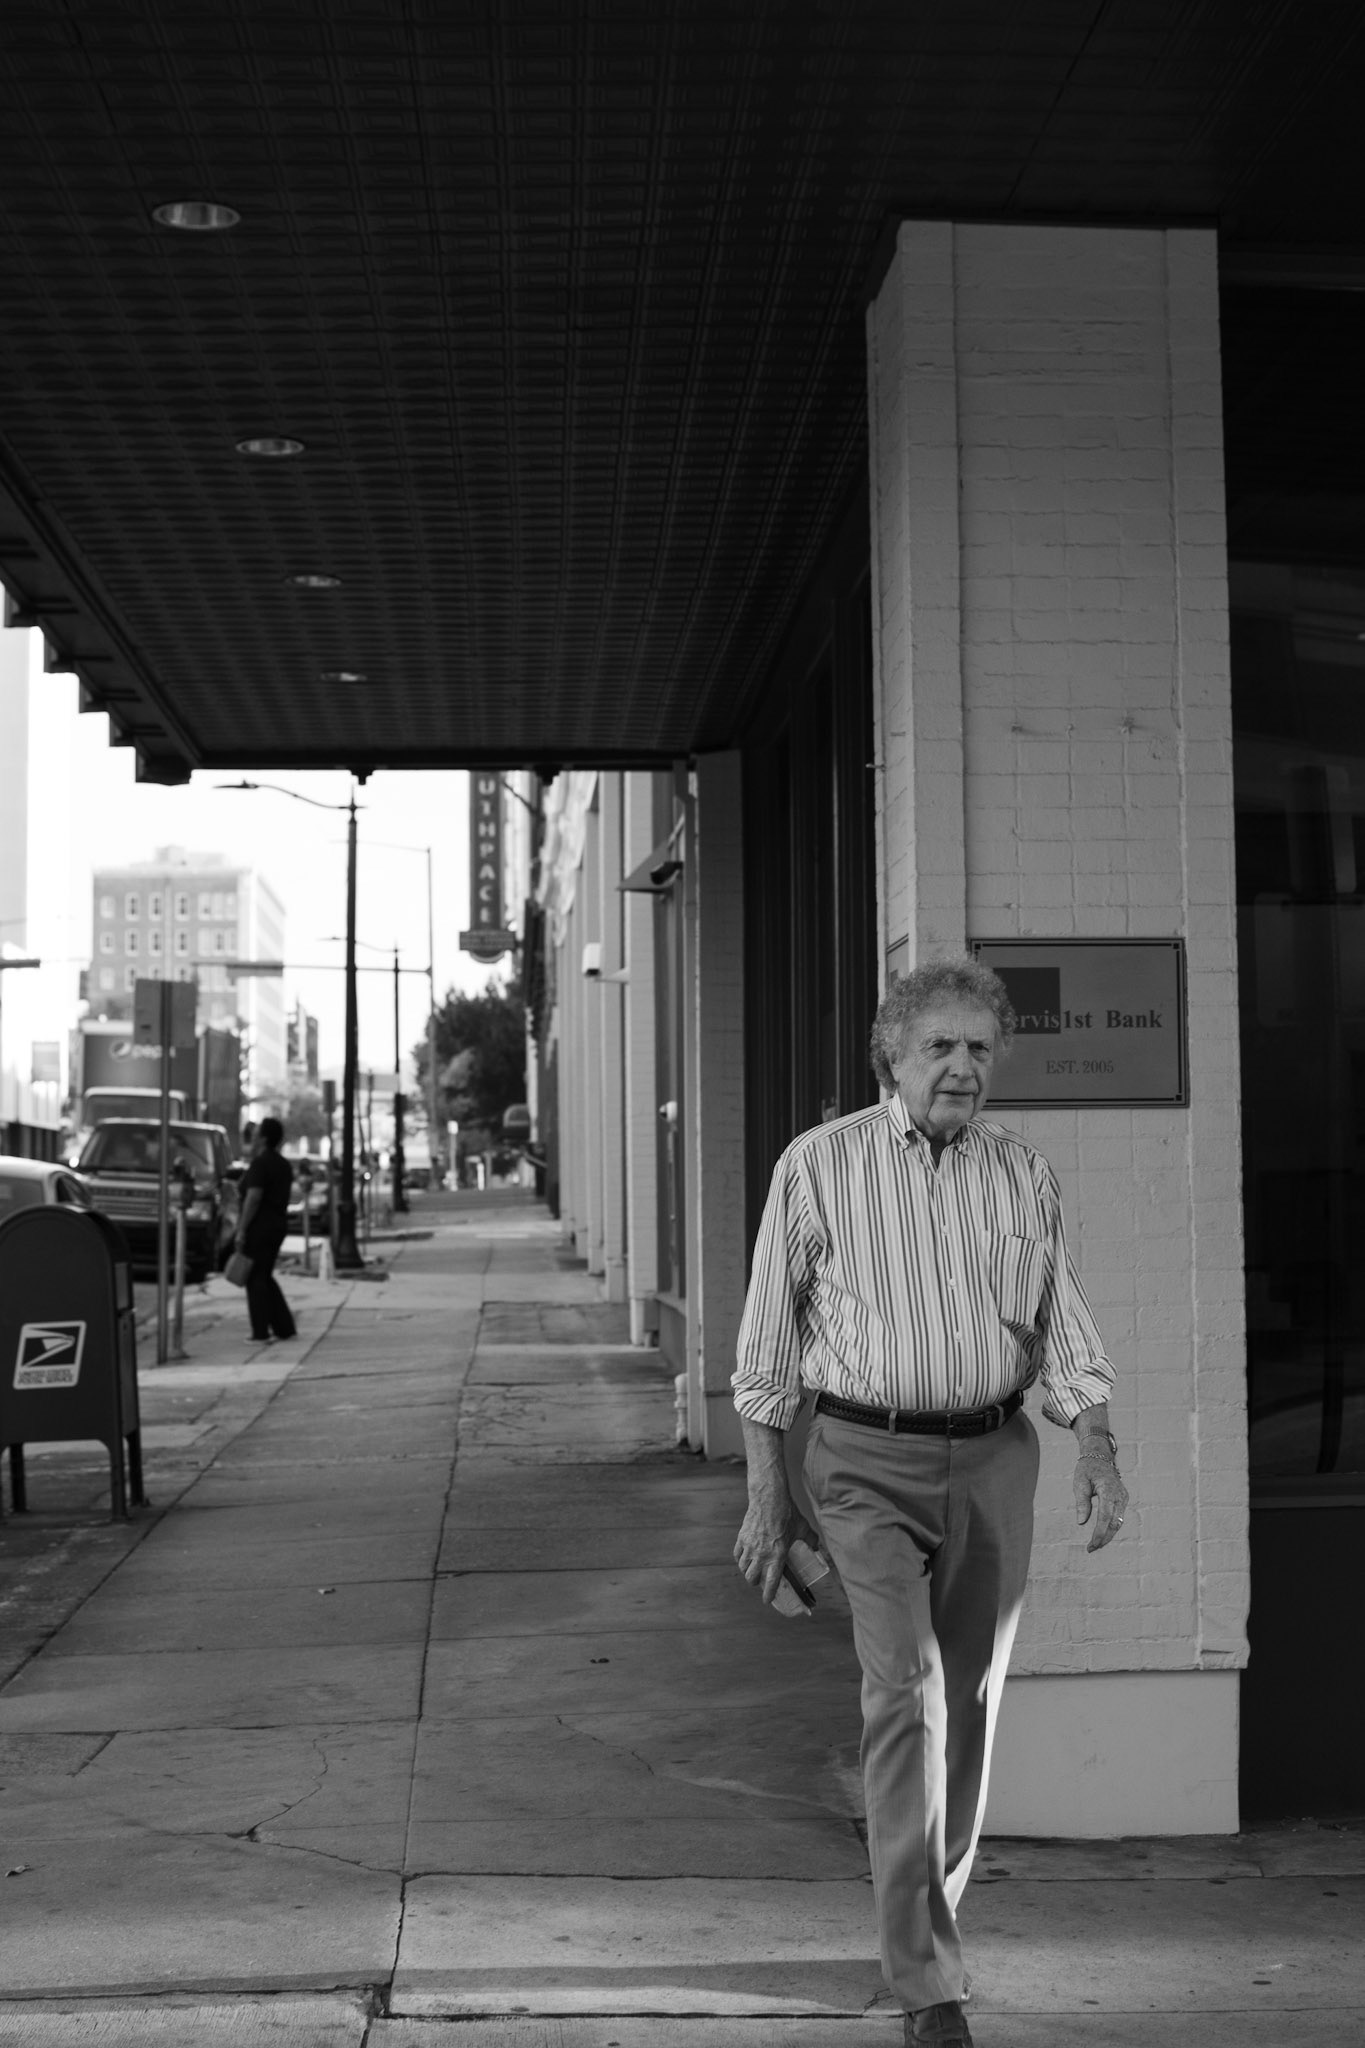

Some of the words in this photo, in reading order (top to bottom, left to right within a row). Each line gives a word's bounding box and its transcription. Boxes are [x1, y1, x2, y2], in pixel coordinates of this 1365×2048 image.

[1107, 1010, 1163, 1029] Bank
[1046, 1060, 1080, 1075] EST.
[1082, 1060, 1114, 1075] 2005
